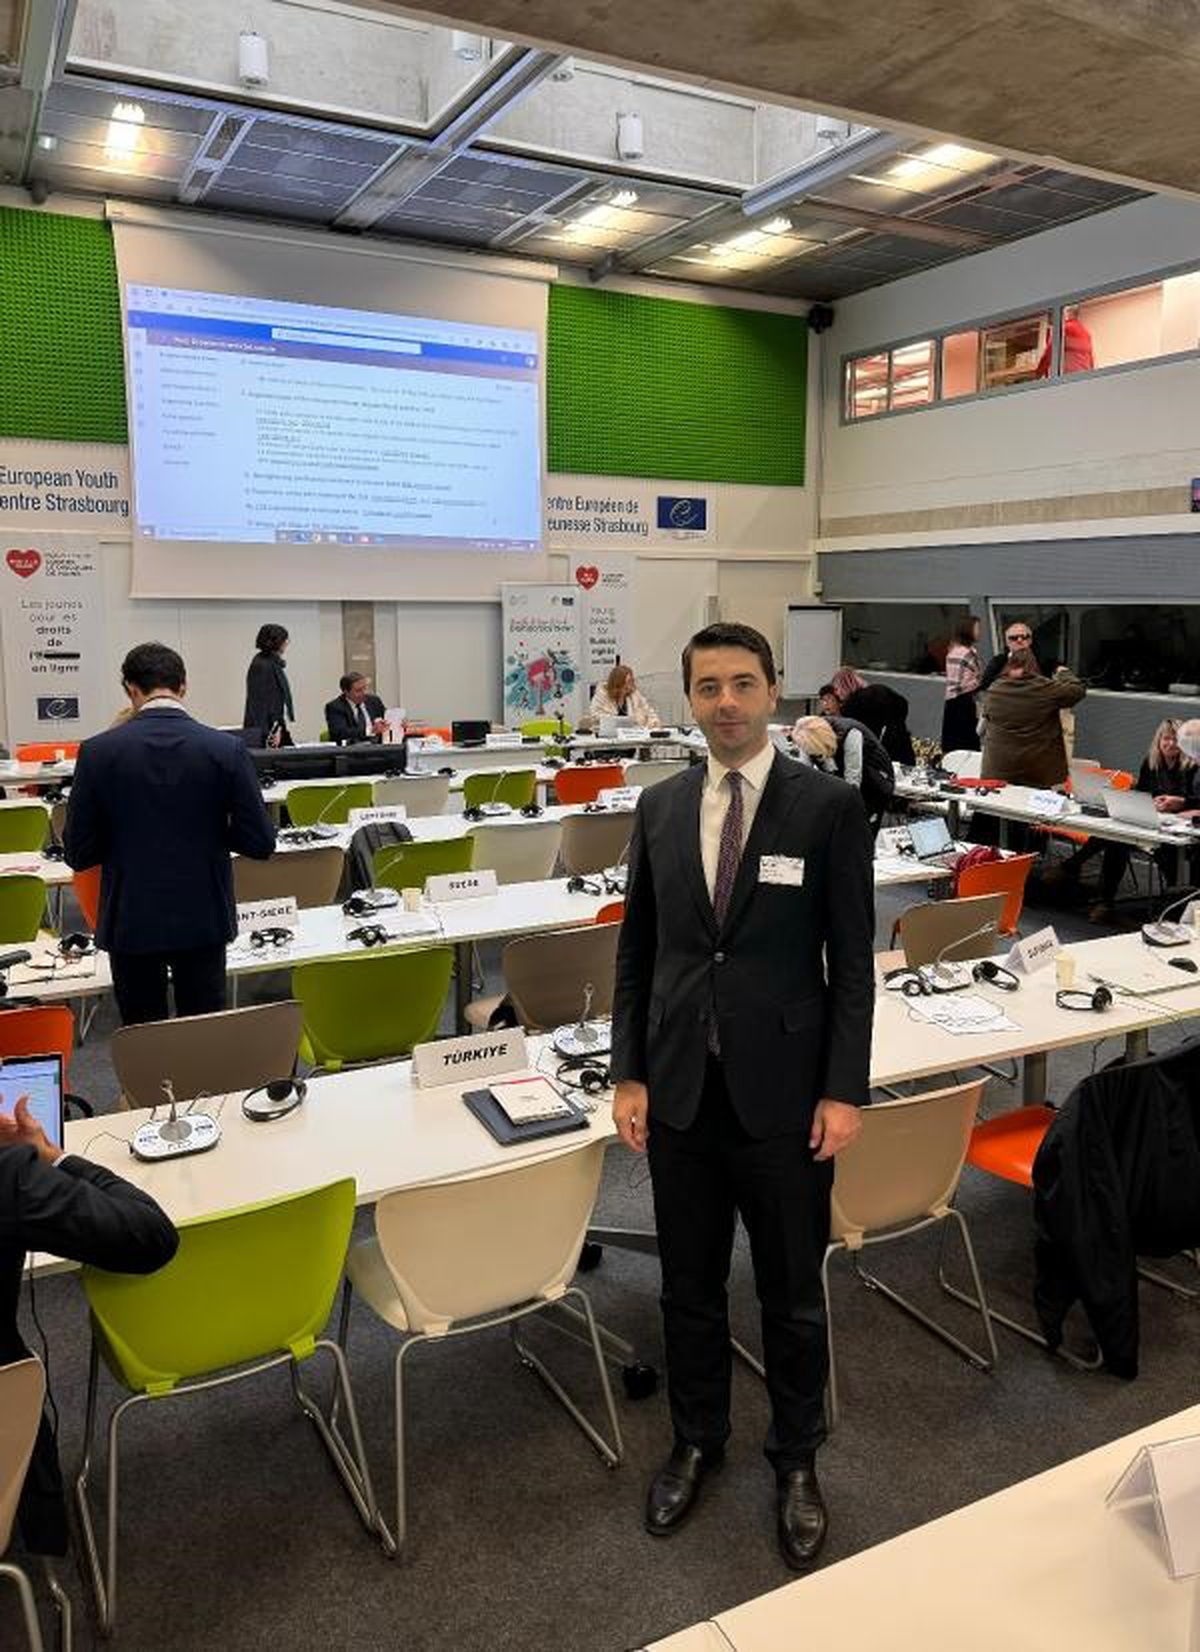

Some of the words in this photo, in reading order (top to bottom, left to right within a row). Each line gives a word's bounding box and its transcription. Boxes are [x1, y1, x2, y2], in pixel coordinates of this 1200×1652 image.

[0, 465, 73, 489] European
[75, 469, 118, 489] Youth
[45, 493, 129, 517] Strasbourg
[626, 499, 640, 514] de
[593, 517, 649, 537] Strasbourg
[35, 625, 72, 635] droits
[47, 637, 63, 647] de
